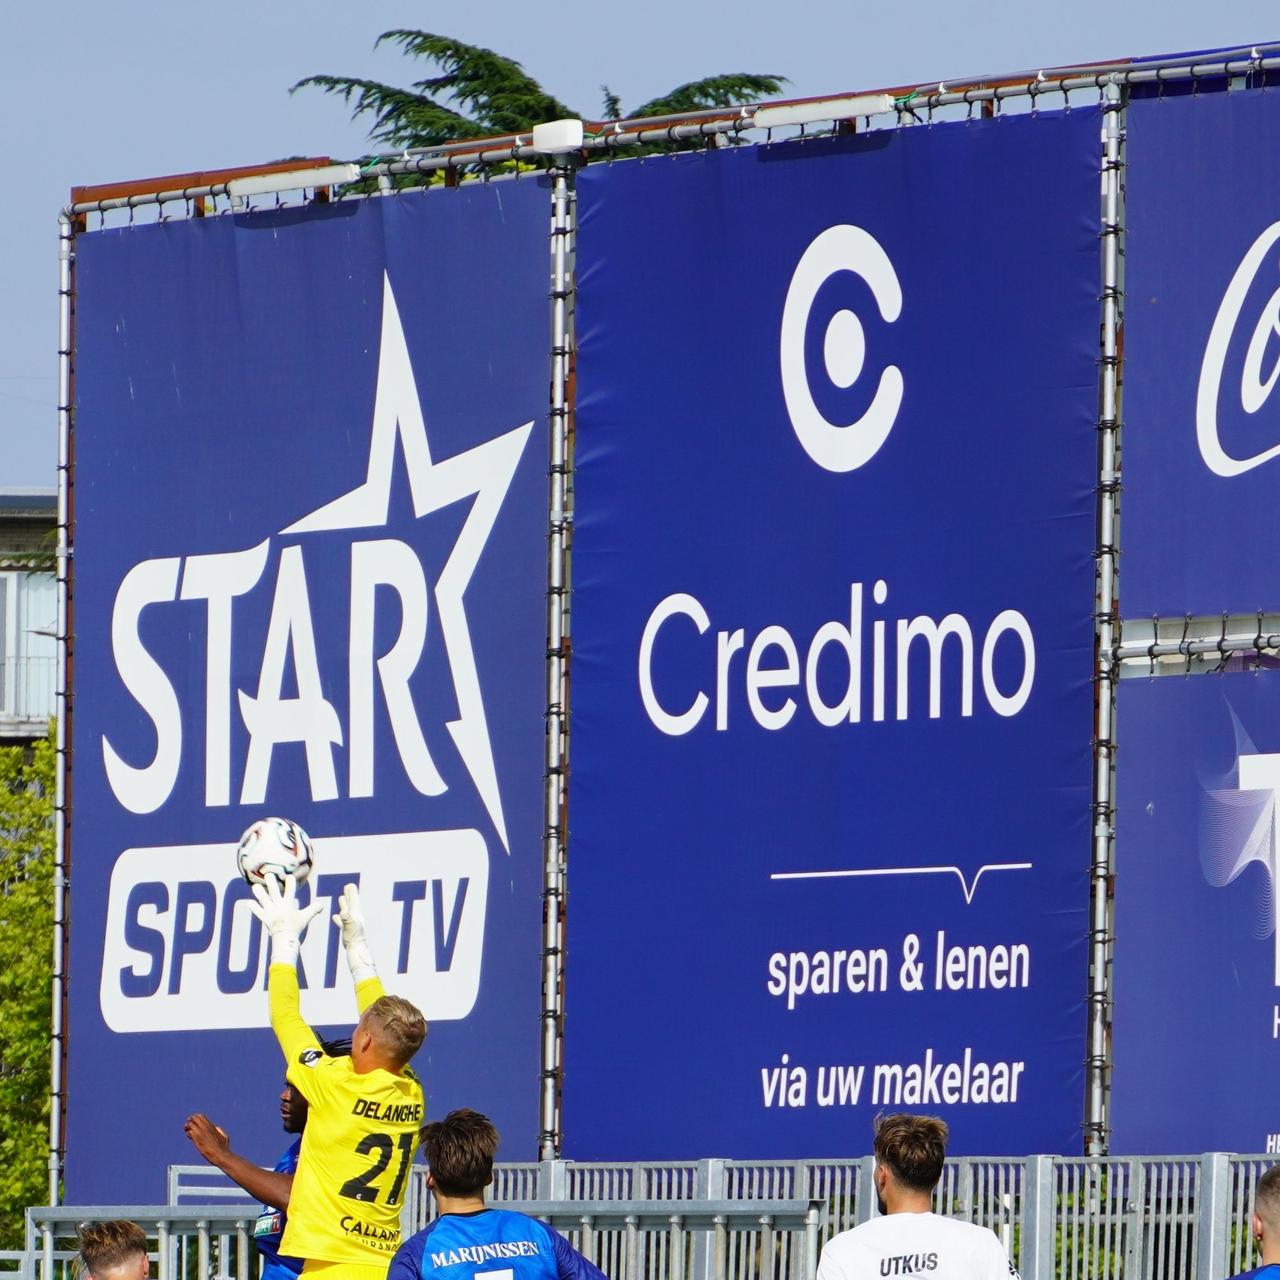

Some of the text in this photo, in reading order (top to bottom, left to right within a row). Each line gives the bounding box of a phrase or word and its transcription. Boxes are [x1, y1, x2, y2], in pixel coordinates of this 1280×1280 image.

[102, 537, 448, 814] STAR
[638, 582, 1036, 737] Credimo
[392, 877, 470, 975] TV
[768, 928, 1030, 1009] sparen & lenen
[761, 1046, 1024, 1107] via uw makelaar
[352, 1098, 422, 1122] DELANGHE
[339, 1133, 414, 1205] 21
[340, 1216, 401, 1243] CALLANT
[431, 1241, 540, 1268] MARIJNISSEN
[880, 1252, 938, 1277] UTKUS
